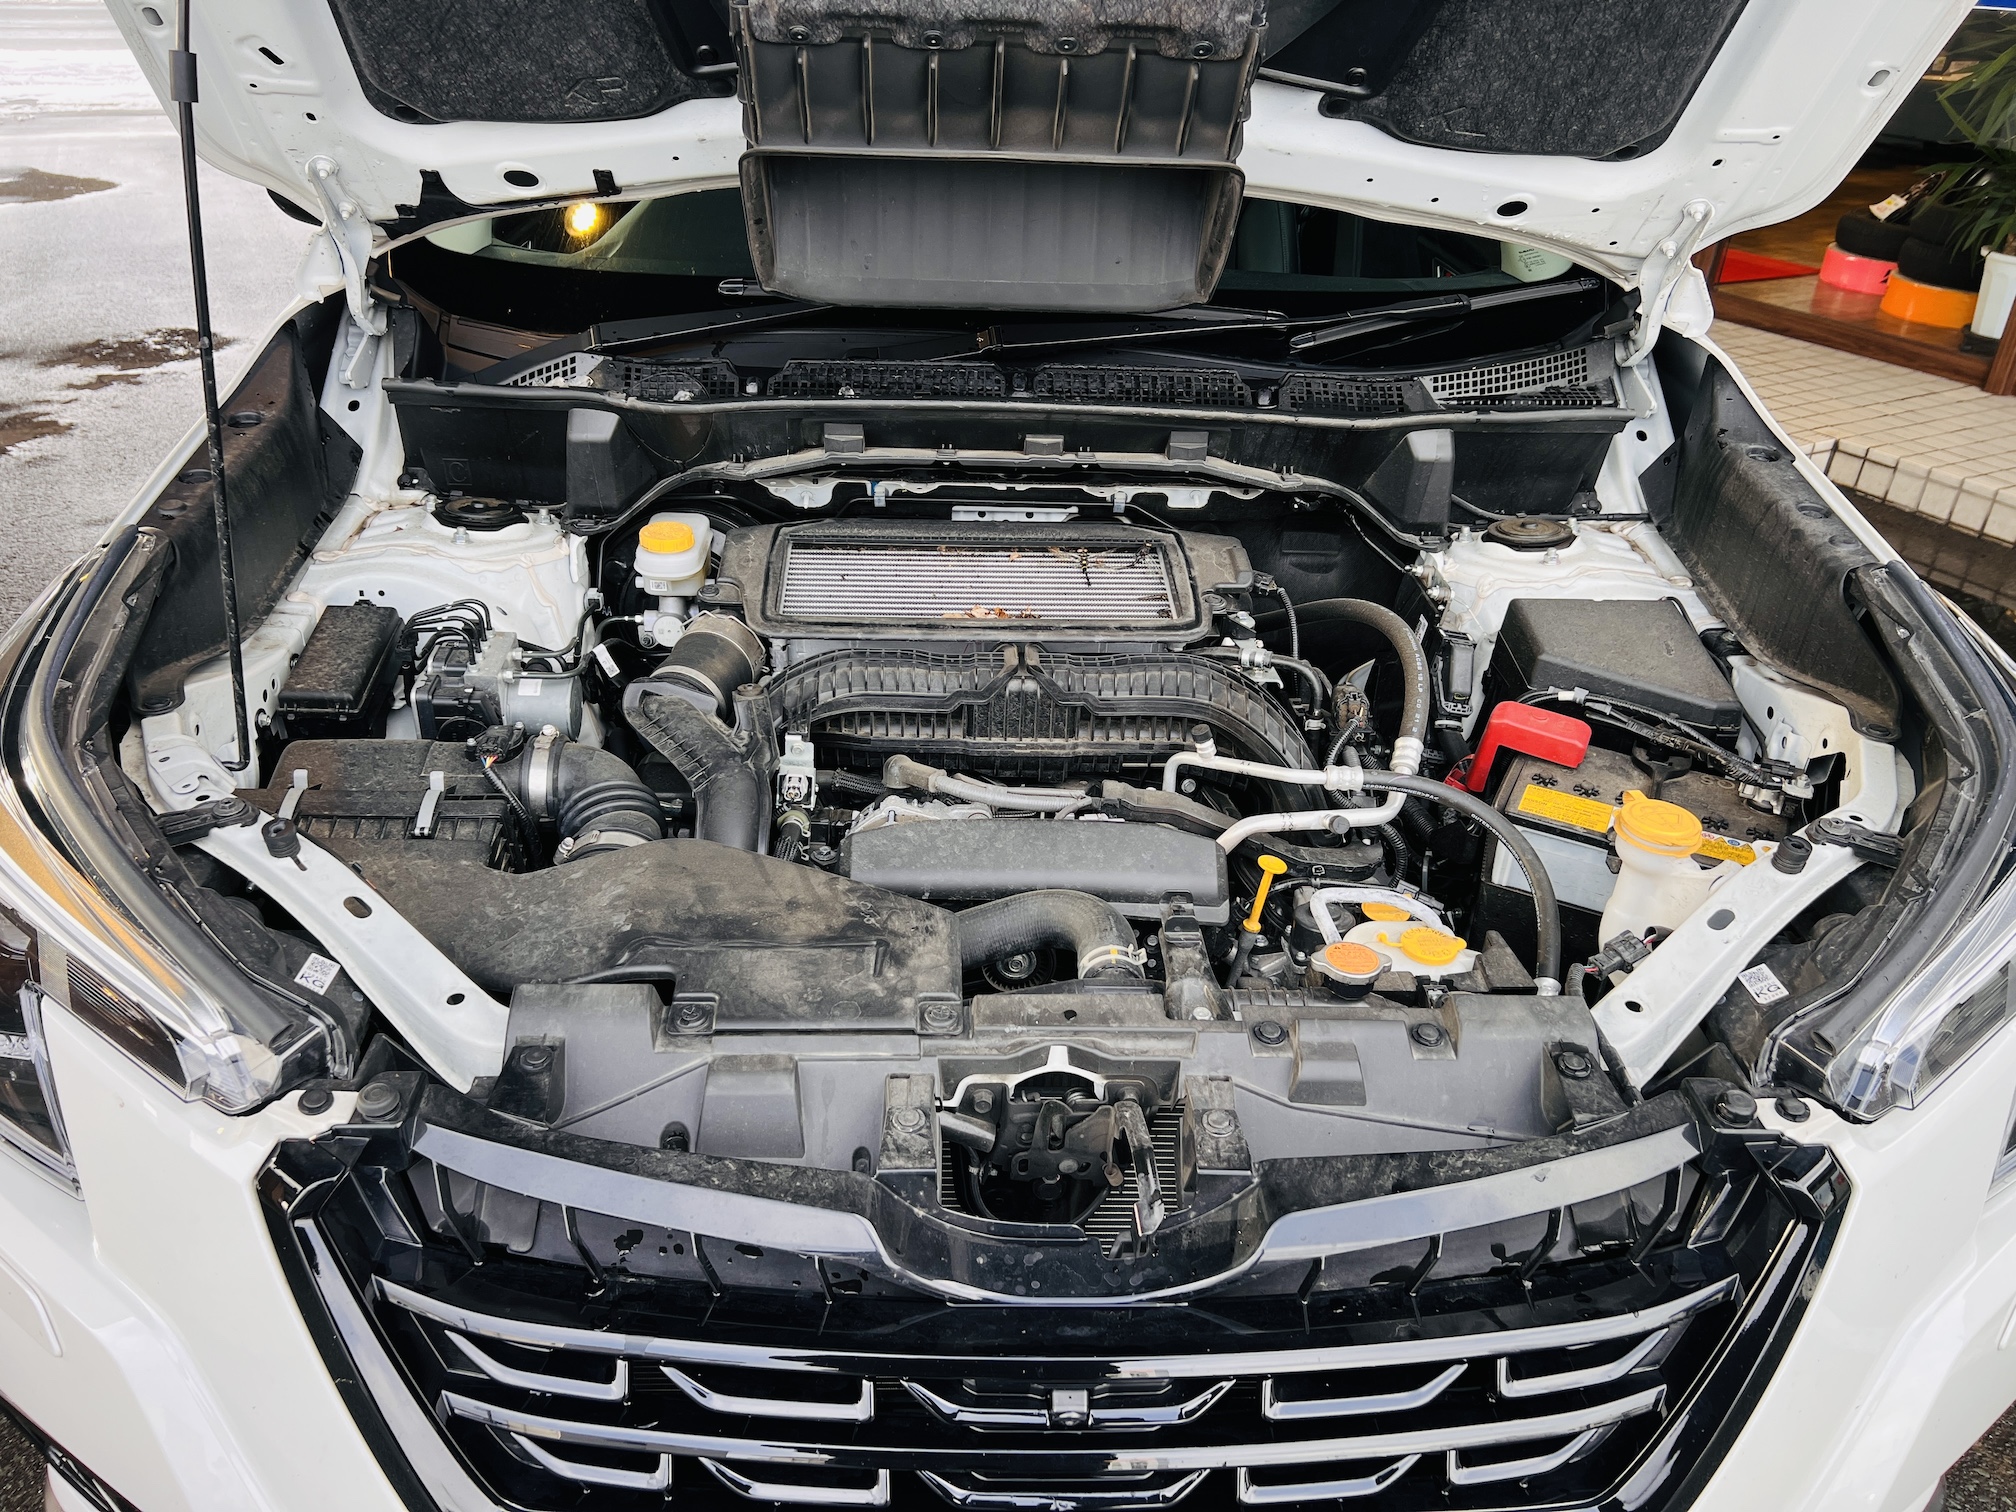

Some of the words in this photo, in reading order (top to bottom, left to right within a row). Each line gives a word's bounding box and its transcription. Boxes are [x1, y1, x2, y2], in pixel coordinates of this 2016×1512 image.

[1417, 683, 1423, 693] LP
[300, 973, 325, 989] KG
[1754, 984, 1781, 998] KG
